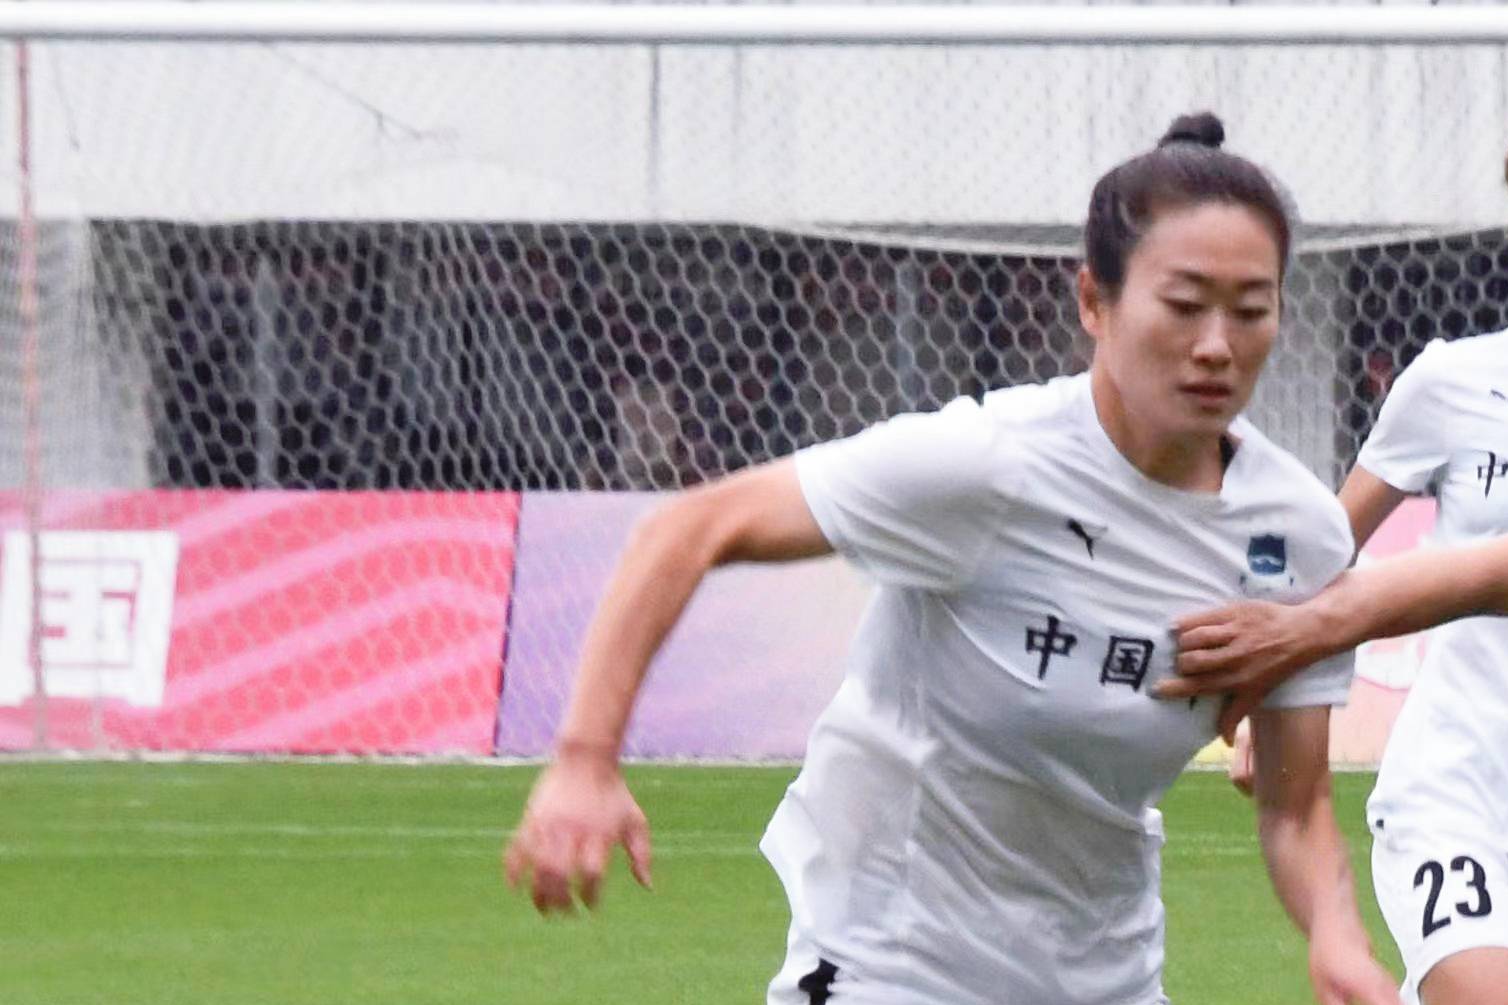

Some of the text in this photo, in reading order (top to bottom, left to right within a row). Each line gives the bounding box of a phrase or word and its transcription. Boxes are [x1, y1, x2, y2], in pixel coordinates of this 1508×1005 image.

[0, 529, 180, 708] 国
[1025, 614, 1154, 692] 中国
[1413, 855, 1492, 939] 23
